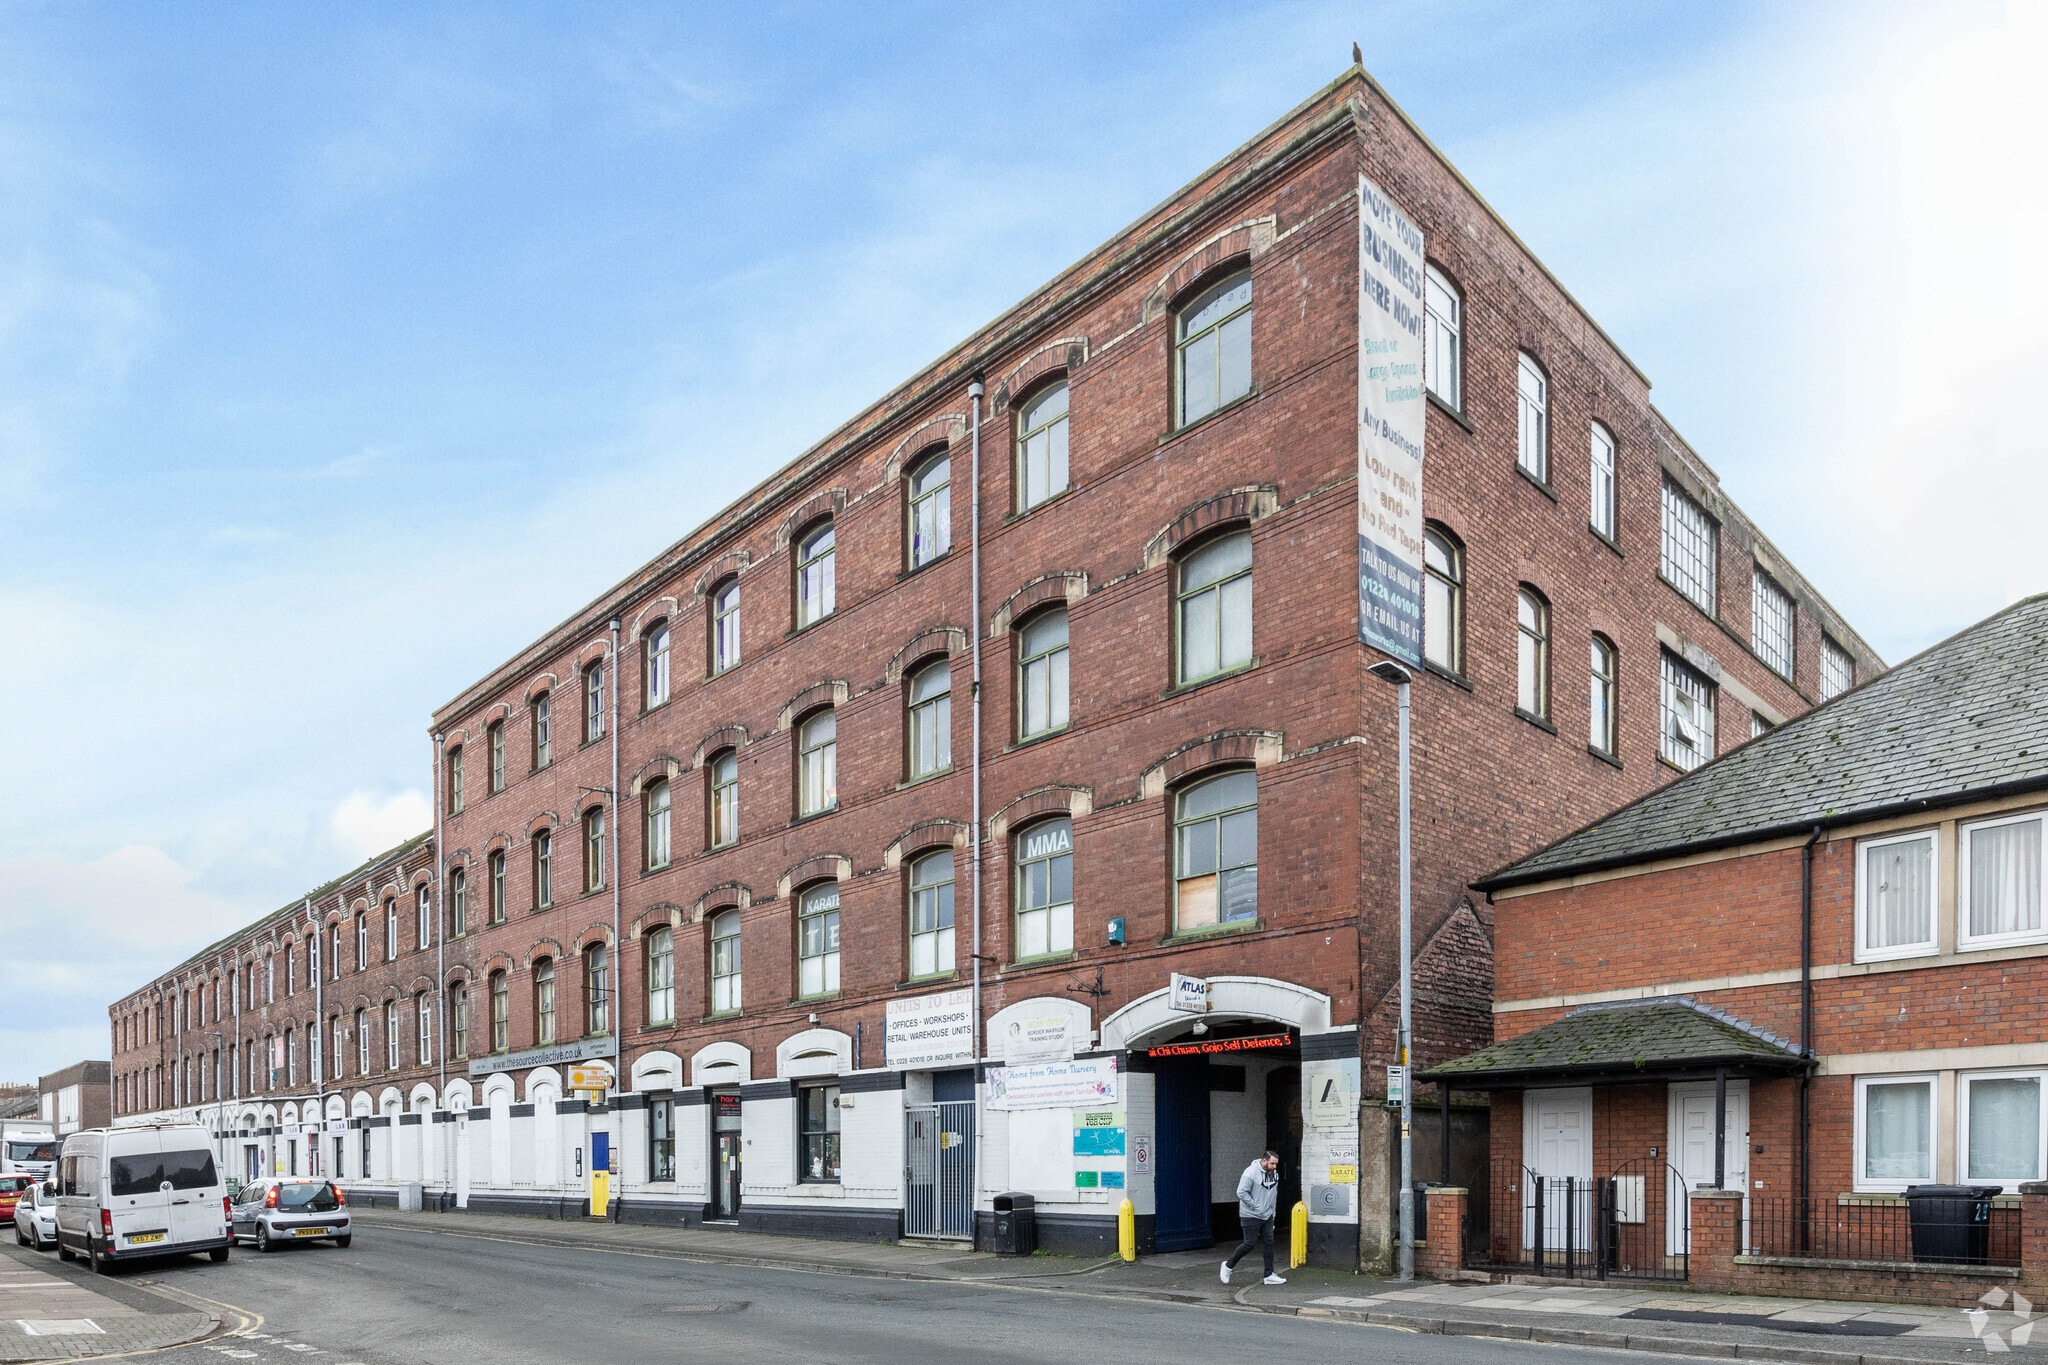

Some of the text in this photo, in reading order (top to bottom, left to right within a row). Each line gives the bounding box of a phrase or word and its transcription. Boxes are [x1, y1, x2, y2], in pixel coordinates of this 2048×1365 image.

[1363, 184, 1421, 257] MOVE YOUR
[1363, 221, 1421, 300] BUSINESS
[1364, 268, 1421, 341] HERE NOW!
[1363, 406, 1421, 463] Any Business!
[1365, 448, 1418, 501] Low rent
[1361, 501, 1376, 527] No
[1398, 525, 1421, 555] Tape
[1361, 547, 1420, 597] TALK TO US NOW ON
[1361, 599, 1420, 645] OR EMAIL US AT
[1027, 829, 1070, 859] MMA
[1180, 981, 1205, 995] ATLAS
[887, 991, 972, 1014] UNITS TO LET
[892, 1012, 966, 1030] OFFICES WORKSHOPS
[951, 1025, 972, 1036] UNITS
[1045, 1026, 1065, 1034] WARRIOR
[492, 1046, 583, 1070] www.thesourcecollective.co.uk
[934, 1053, 953, 1061] INQUIRE
[955, 1051, 972, 1059] WITHIN
[1156, 1046, 1171, 1057] Chi
[1171, 1044, 1201, 1056] Chuan,
[1201, 1042, 1224, 1054] Gojo
[1223, 1040, 1241, 1051] Self
[1241, 1037, 1283, 1050] Defence,
[1284, 1033, 1292, 1046] 5
[1007, 1064, 1097, 1080] Home from Home Nursery
